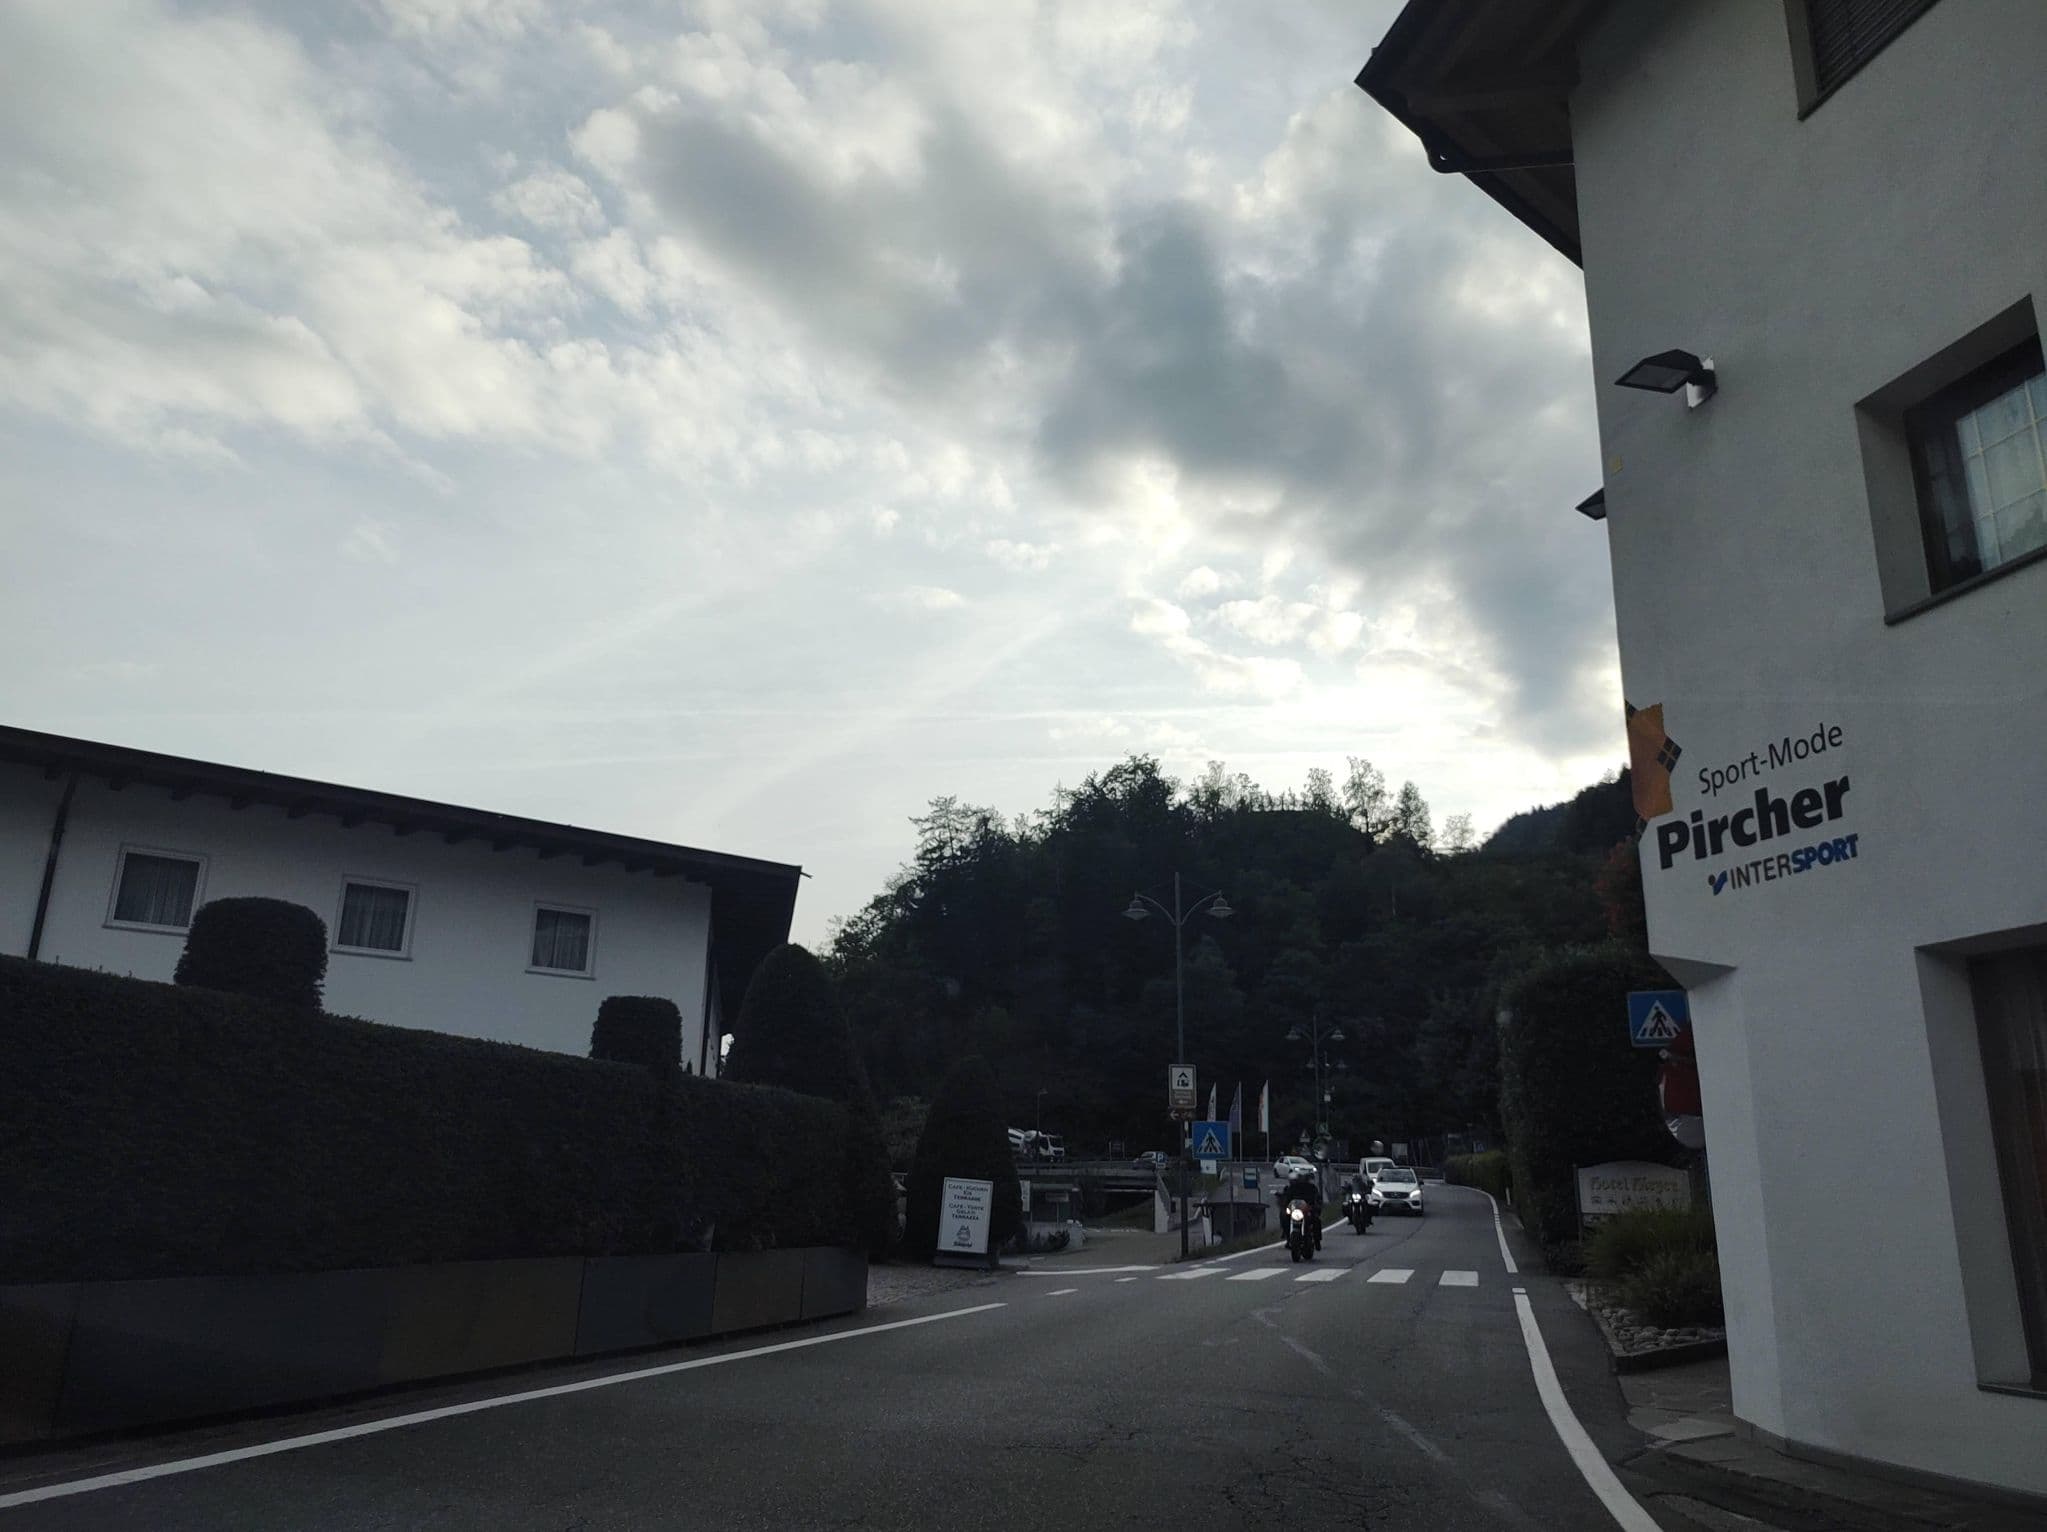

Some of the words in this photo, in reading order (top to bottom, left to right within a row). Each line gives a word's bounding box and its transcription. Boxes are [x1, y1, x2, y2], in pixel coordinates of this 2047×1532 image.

[1698, 723, 1843, 796] Sport-Mode
[1656, 775, 1851, 870] Pircher
[1729, 833, 1859, 890] INTERSPORT
